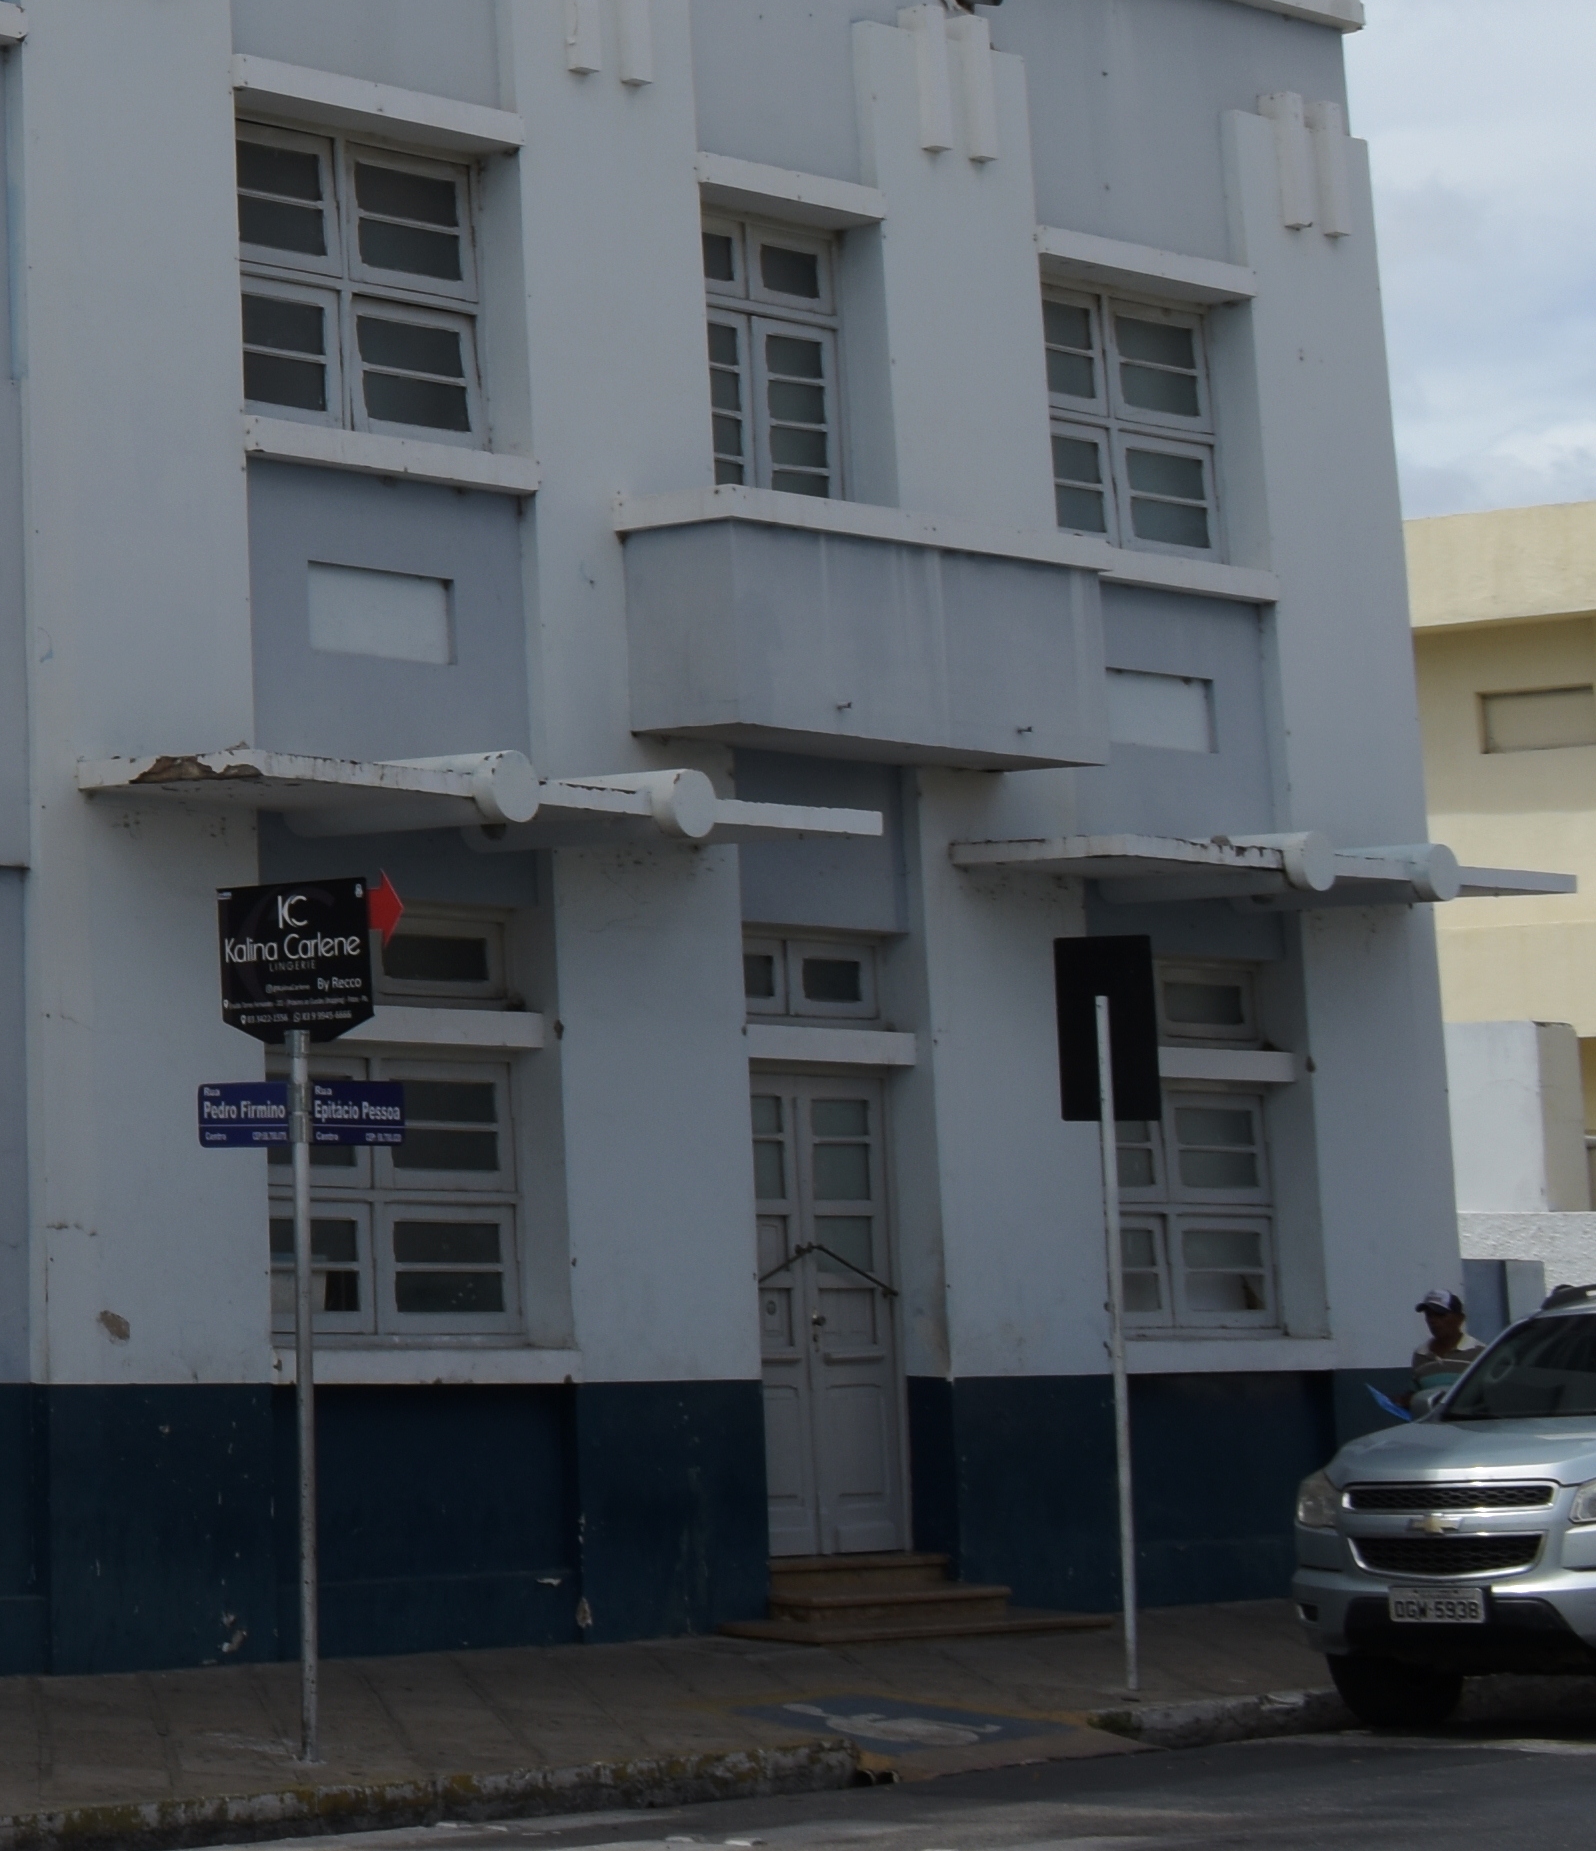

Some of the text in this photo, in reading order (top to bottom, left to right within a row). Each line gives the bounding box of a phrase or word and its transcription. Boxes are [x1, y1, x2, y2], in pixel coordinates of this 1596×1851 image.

[225, 932, 361, 963] Kalina Carlene
[268, 959, 317, 972] LINGERIE
[317, 976, 362, 992] By Recco
[203, 1086, 221, 1097] Rua
[314, 1085, 333, 1096] Rua
[203, 1100, 286, 1119] Pedro Firmino
[314, 1100, 401, 1123] Epitácio Pessoa
